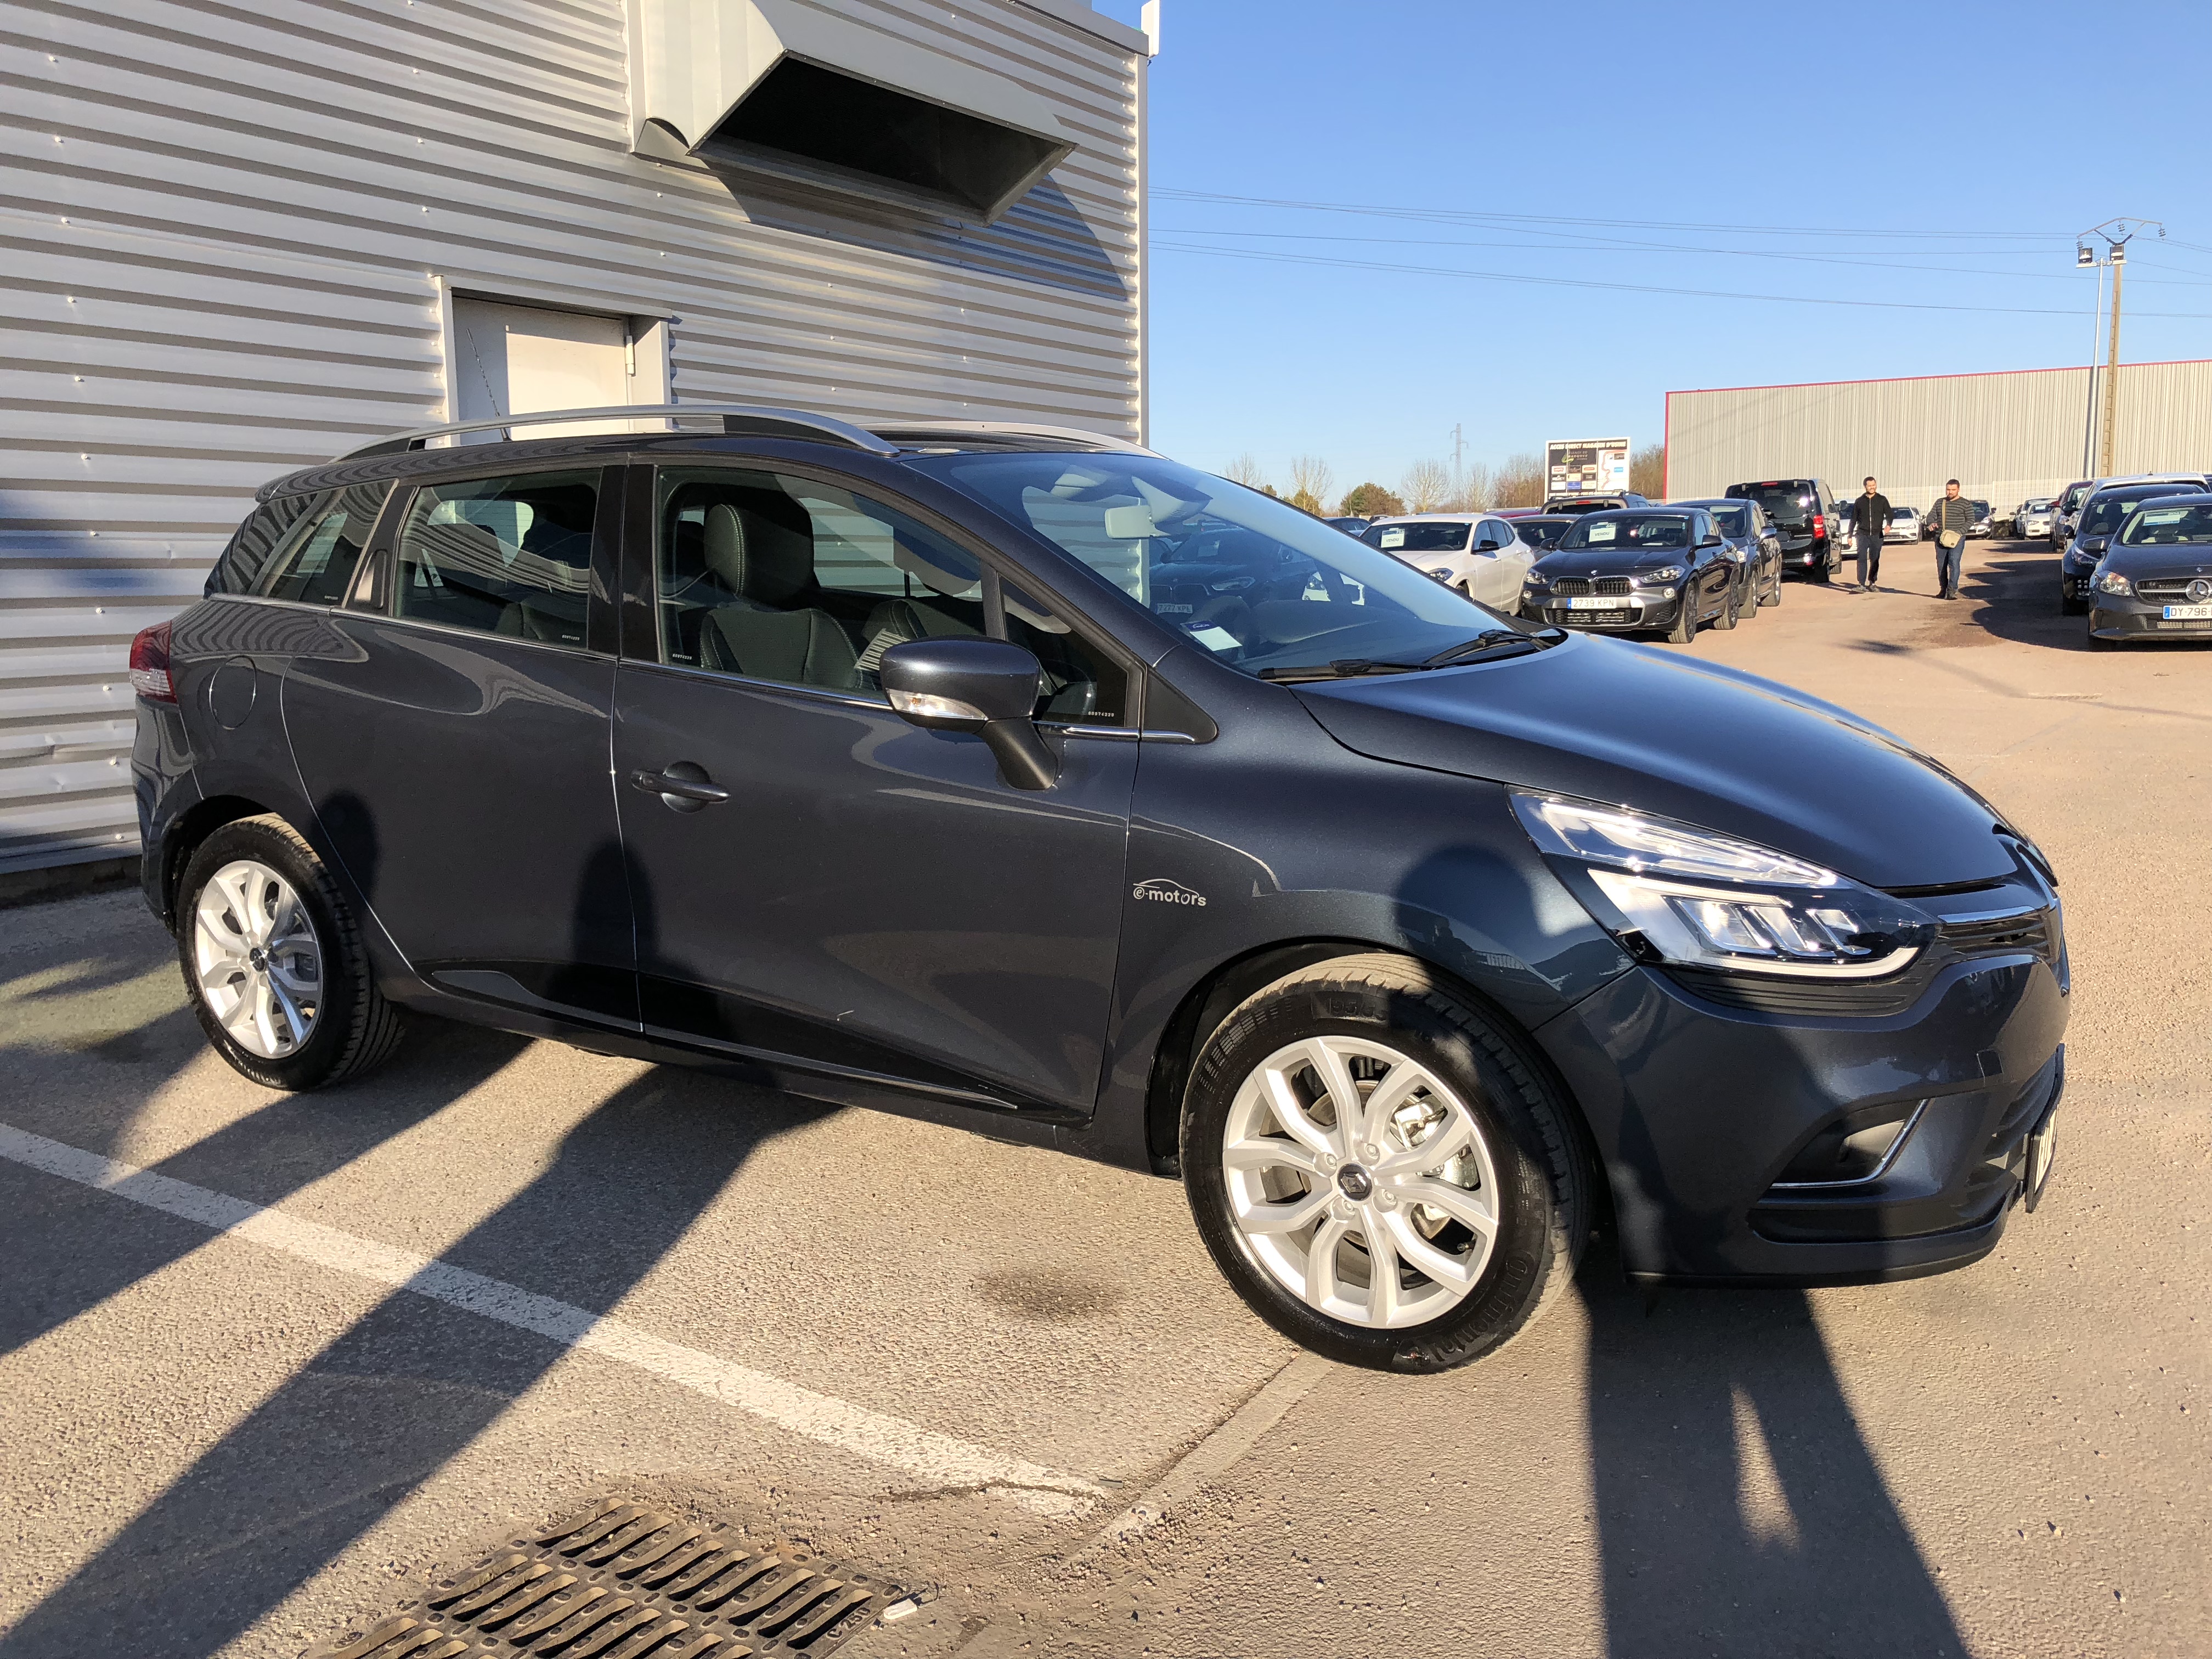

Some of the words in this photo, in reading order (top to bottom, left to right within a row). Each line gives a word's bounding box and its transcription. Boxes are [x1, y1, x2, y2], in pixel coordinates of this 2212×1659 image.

[1573, 599, 1595, 607] 2739
[1598, 599, 1614, 607] KPN
[2170, 607, 2212, 617] DY-796-
